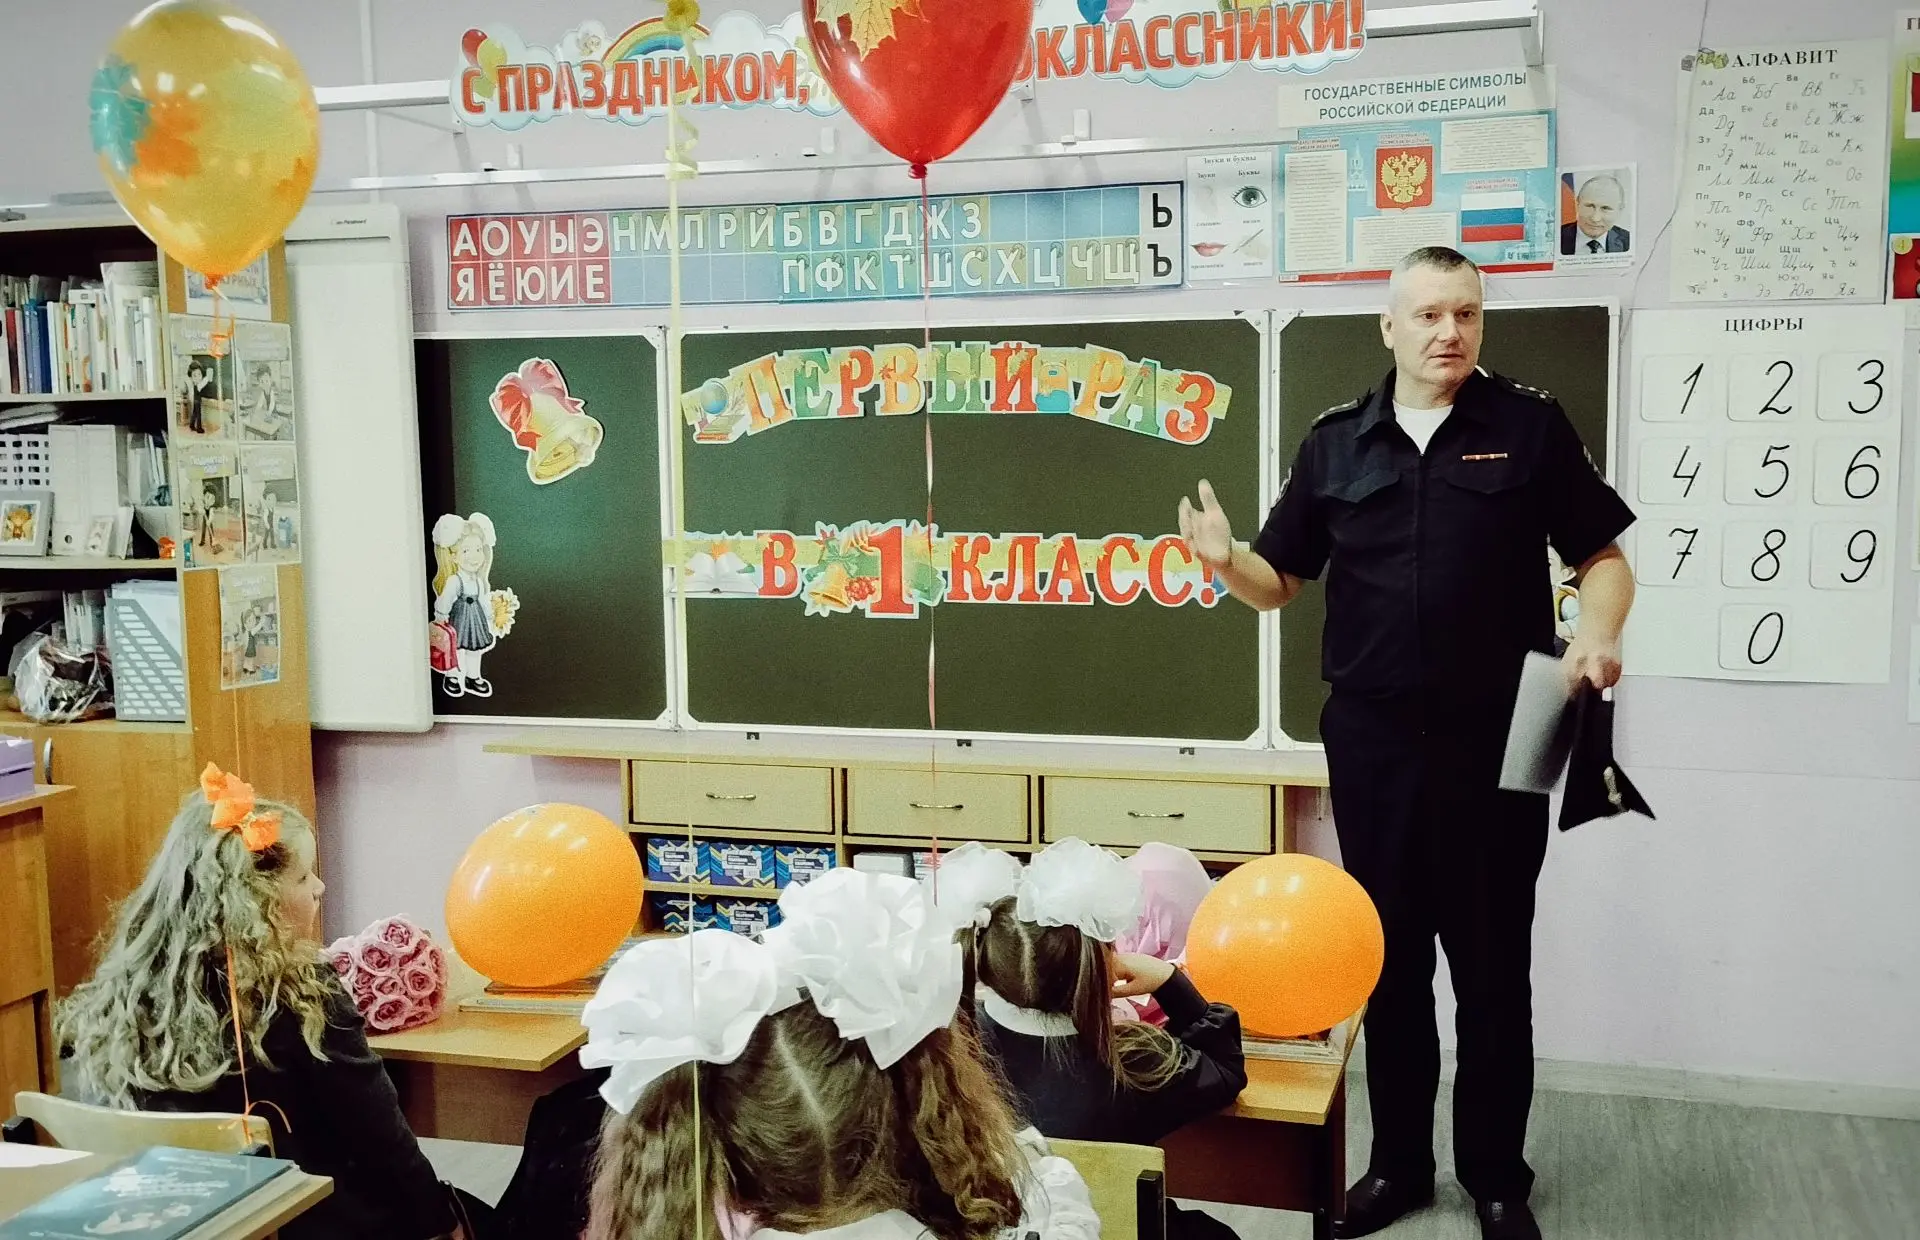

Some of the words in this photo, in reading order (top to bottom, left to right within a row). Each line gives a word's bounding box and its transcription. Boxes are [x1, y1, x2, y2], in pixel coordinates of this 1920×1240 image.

[462, 67, 486, 114] С
[497, 49, 809, 116] ПРАЗДНИКОМ,
[1731, 49, 1838, 68] АЛФАВИТ
[1304, 77, 1446, 101] ГОСУДАРСТВЕННЫЕ
[1449, 72, 1527, 90] СИМВОЛЫ
[1319, 100, 1415, 120] РОССИЙСКОЙ
[1418, 95, 1507, 113] ФЕДЕРАЦИИ
[1724, 317, 1806, 333] ЦИФРЫ
[746, 343, 1038, 430] ПЕРВЫЙ
[1073, 345, 1217, 443] РАЗ
[1681, 363, 1704, 414] 1
[1759, 360, 1793, 415] 2
[1848, 359, 1884, 414] 3
[1672, 445, 1701, 498] 4
[1754, 444, 1791, 498] 5
[1844, 445, 1881, 499] 6
[757, 531, 798, 597] В
[866, 523, 916, 616] 1
[1669, 527, 1698, 579] 7
[1750, 529, 1786, 582] 8
[1840, 529, 1877, 583] 9
[1747, 611, 1784, 665] 0
